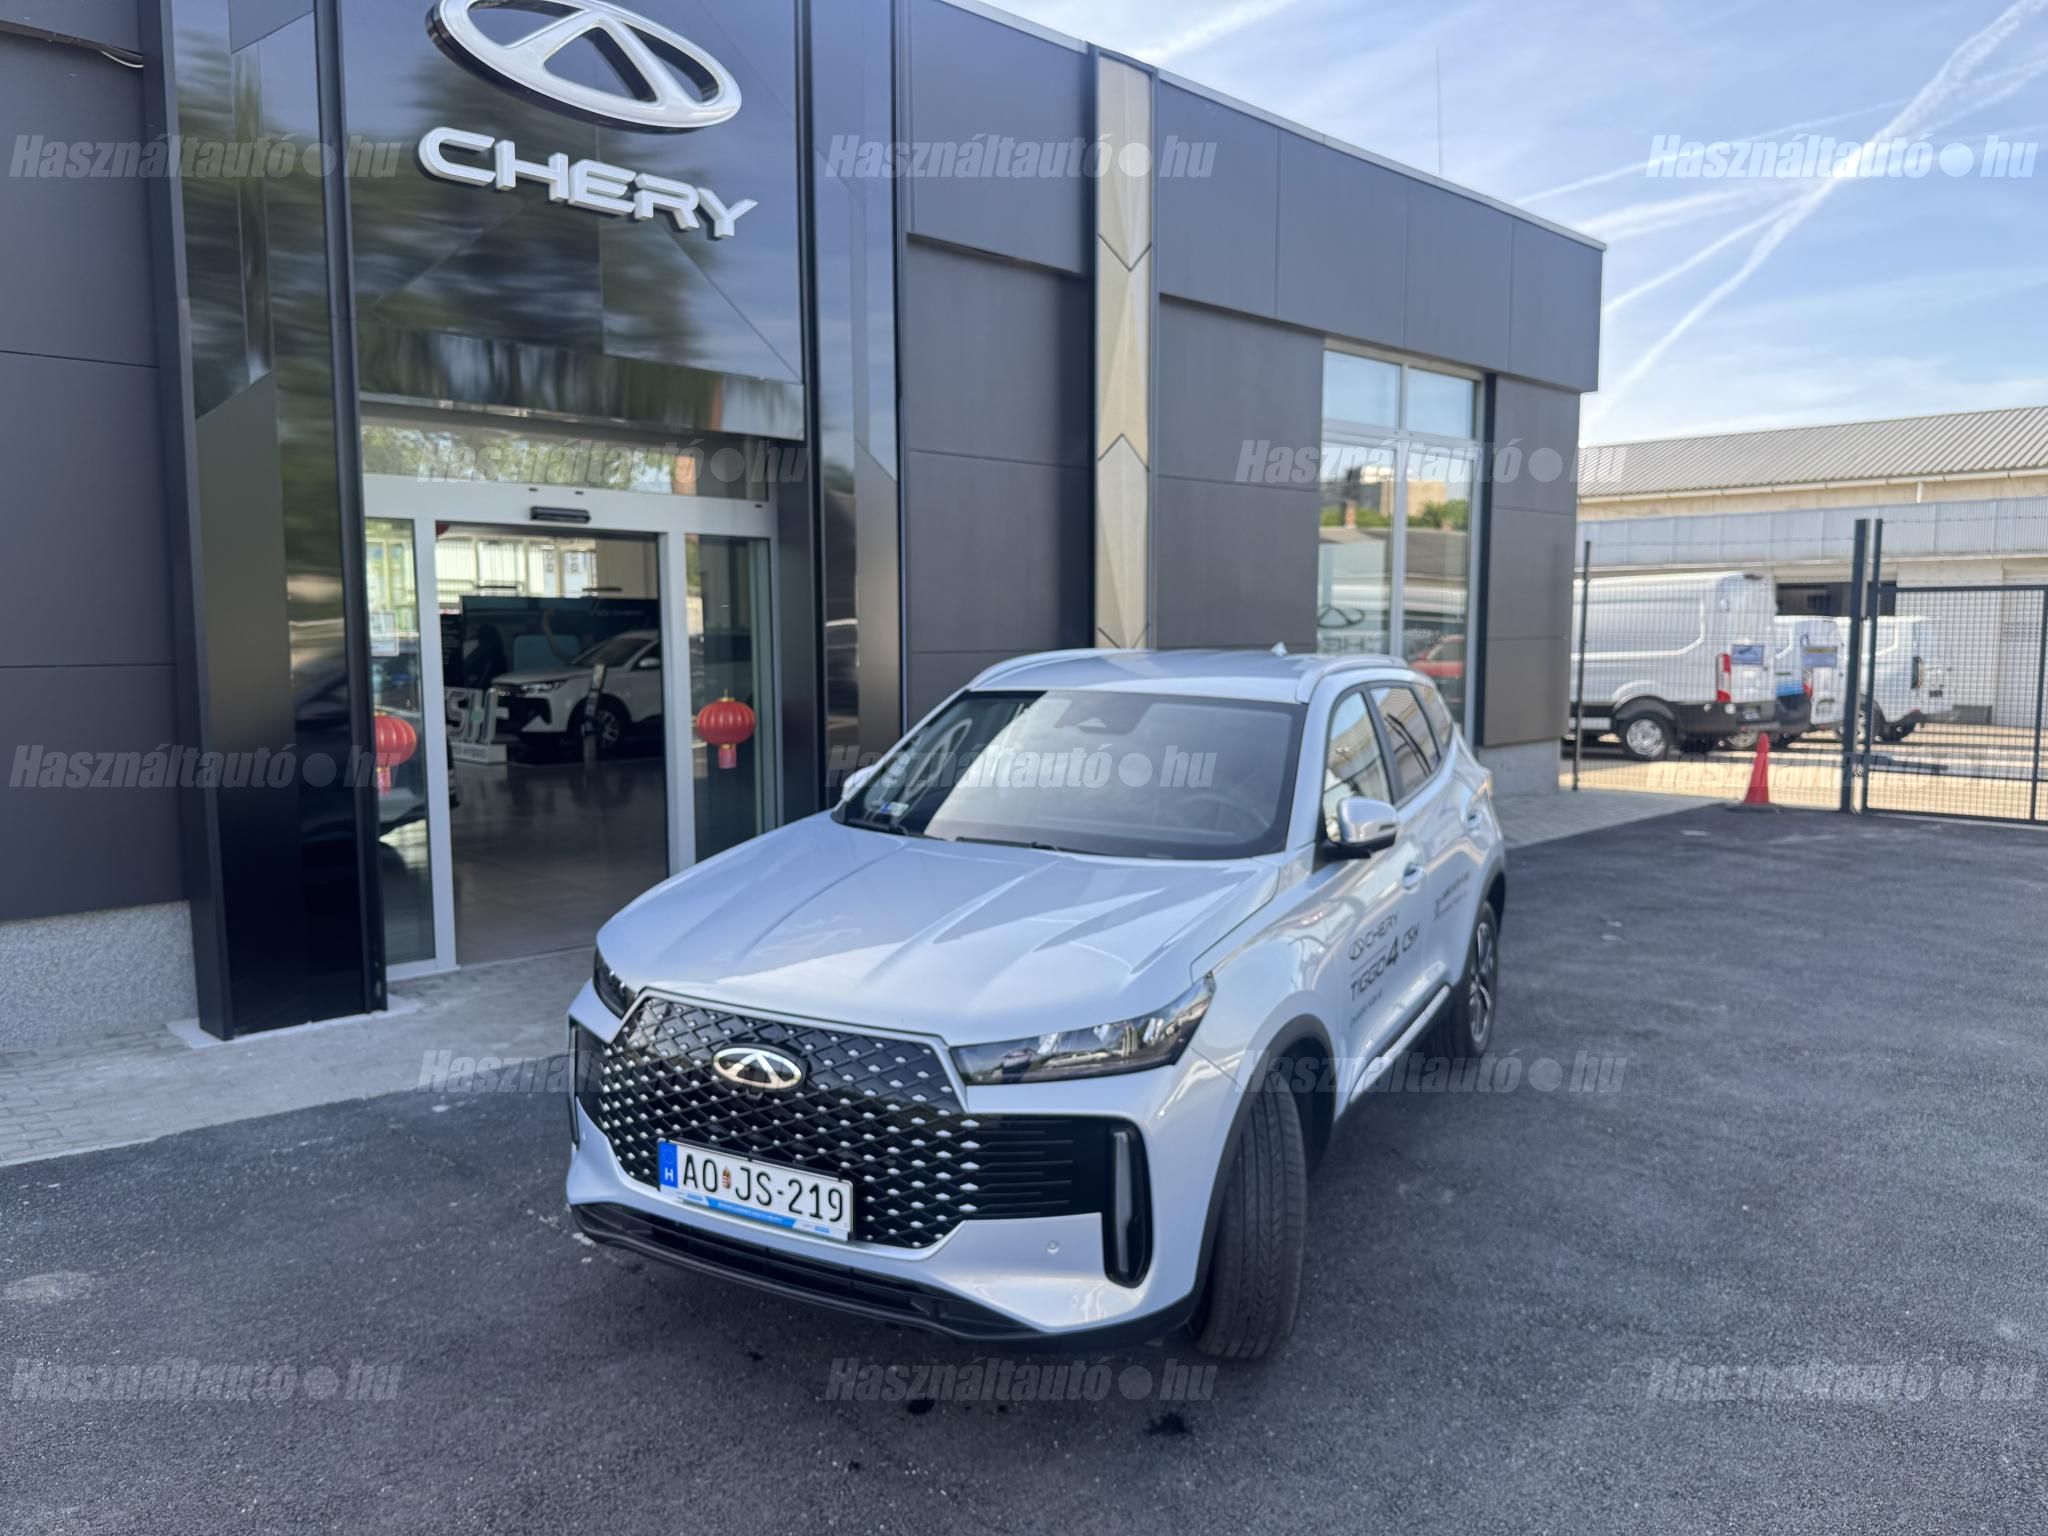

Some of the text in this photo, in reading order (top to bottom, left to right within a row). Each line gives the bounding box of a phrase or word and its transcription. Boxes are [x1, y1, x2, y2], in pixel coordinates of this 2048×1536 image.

[418, 127, 759, 238] CHERY
[664, 1167, 674, 1182] H
[735, 1166, 844, 1223] JS-219
